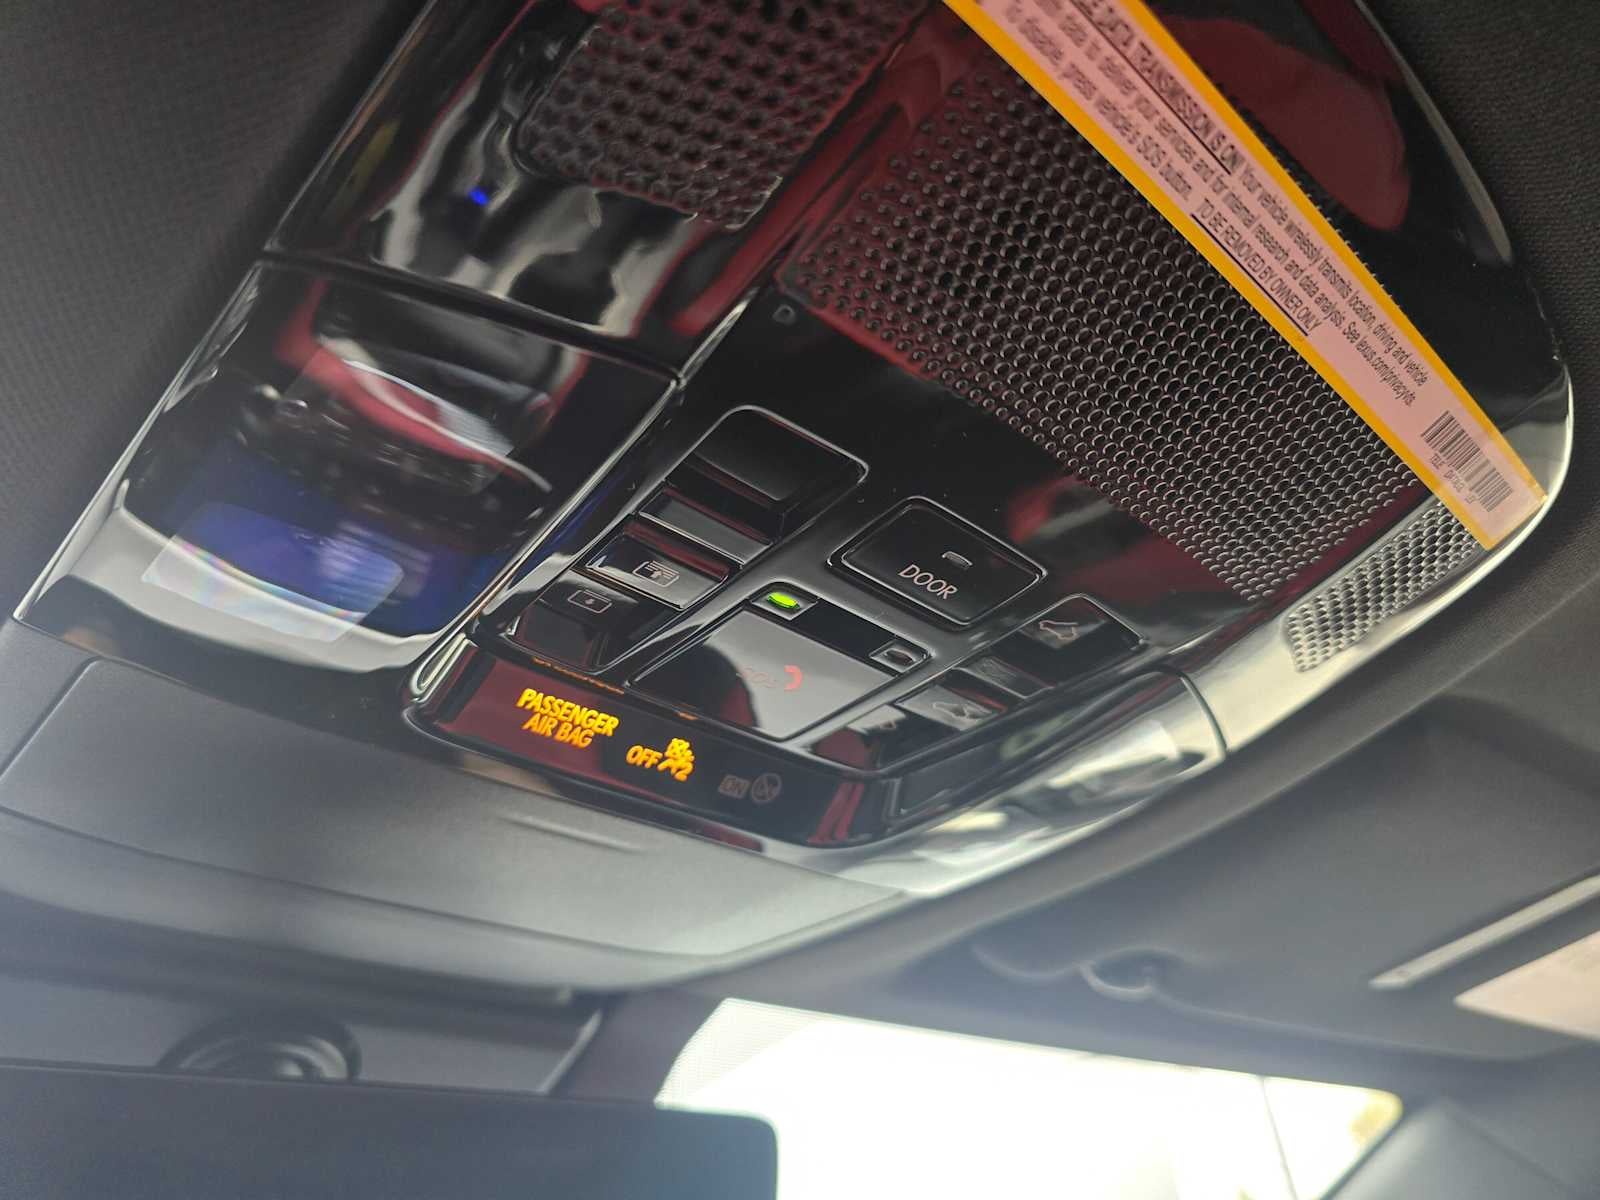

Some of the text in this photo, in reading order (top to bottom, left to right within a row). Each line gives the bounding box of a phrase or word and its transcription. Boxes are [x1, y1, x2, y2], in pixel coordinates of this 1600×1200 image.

[1136, 135, 1166, 168] SOS
[1196, 197, 1322, 332] TO BE REMOVED BY OWNER ONLY
[1206, 130, 1228, 152] IS
[1257, 189, 1289, 226] vehicle
[1284, 221, 1323, 268] wirelessly
[1318, 256, 1353, 300] transmits
[1348, 290, 1377, 330] location,
[1372, 322, 1399, 354] driving
[1391, 346, 1413, 366] and
[1403, 358, 1429, 388] vehicle
[1252, 223, 1291, 263] research
[1284, 258, 1306, 281] and
[1298, 274, 1320, 298] data
[1342, 321, 1360, 344] See
[898, 563, 958, 600] DOOR
[515, 687, 620, 737] PASSENGER
[522, 712, 595, 749] AIR BAG
[625, 745, 663, 769] OFF
